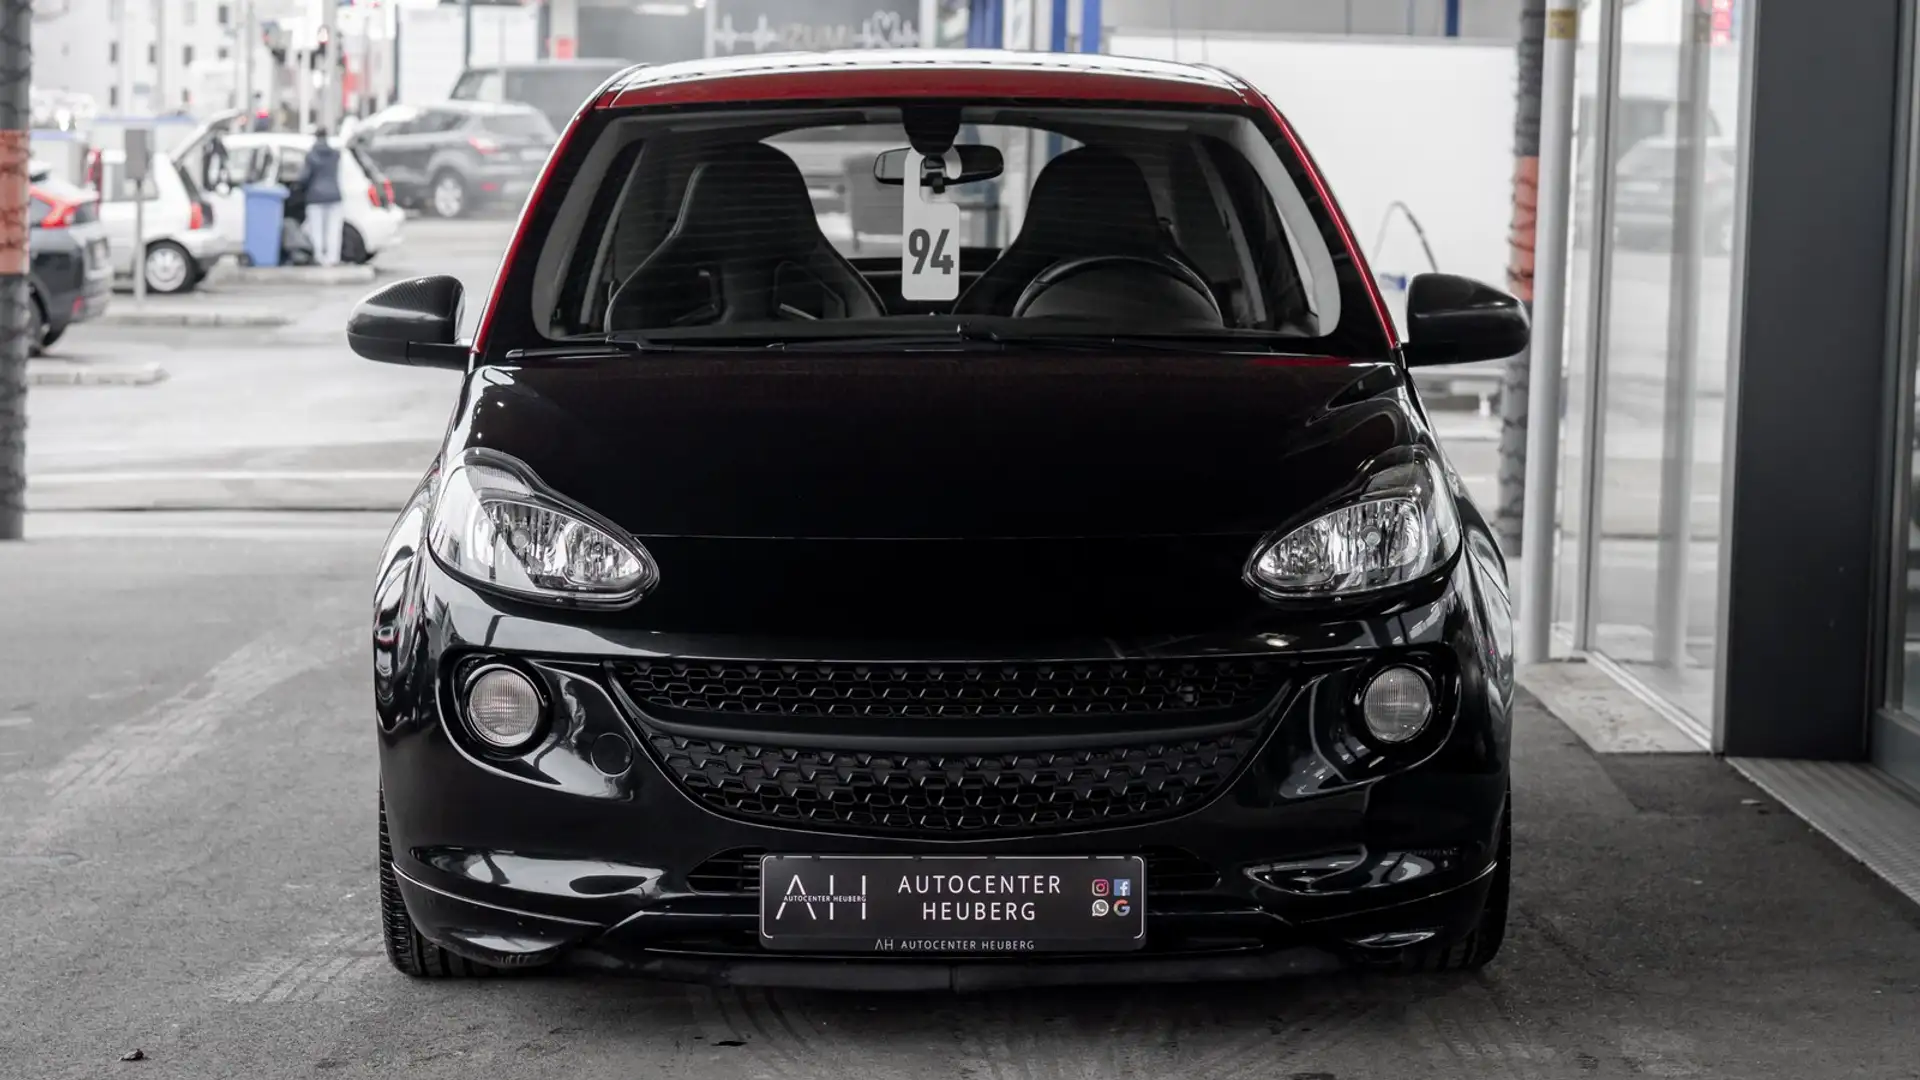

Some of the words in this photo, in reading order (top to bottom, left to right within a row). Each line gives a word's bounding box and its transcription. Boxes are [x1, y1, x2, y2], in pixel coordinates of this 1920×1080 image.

[908, 228, 954, 275] 94
[898, 875, 1061, 894] AUTOCENTER
[783, 895, 830, 903] AUTOCENTER
[833, 895, 867, 903] HEUBERG
[923, 902, 1036, 921] HEUBERG
[874, 938, 894, 951] AH
[900, 940, 976, 950] AUTOCENTER
[981, 940, 1035, 950] HEUBERG
